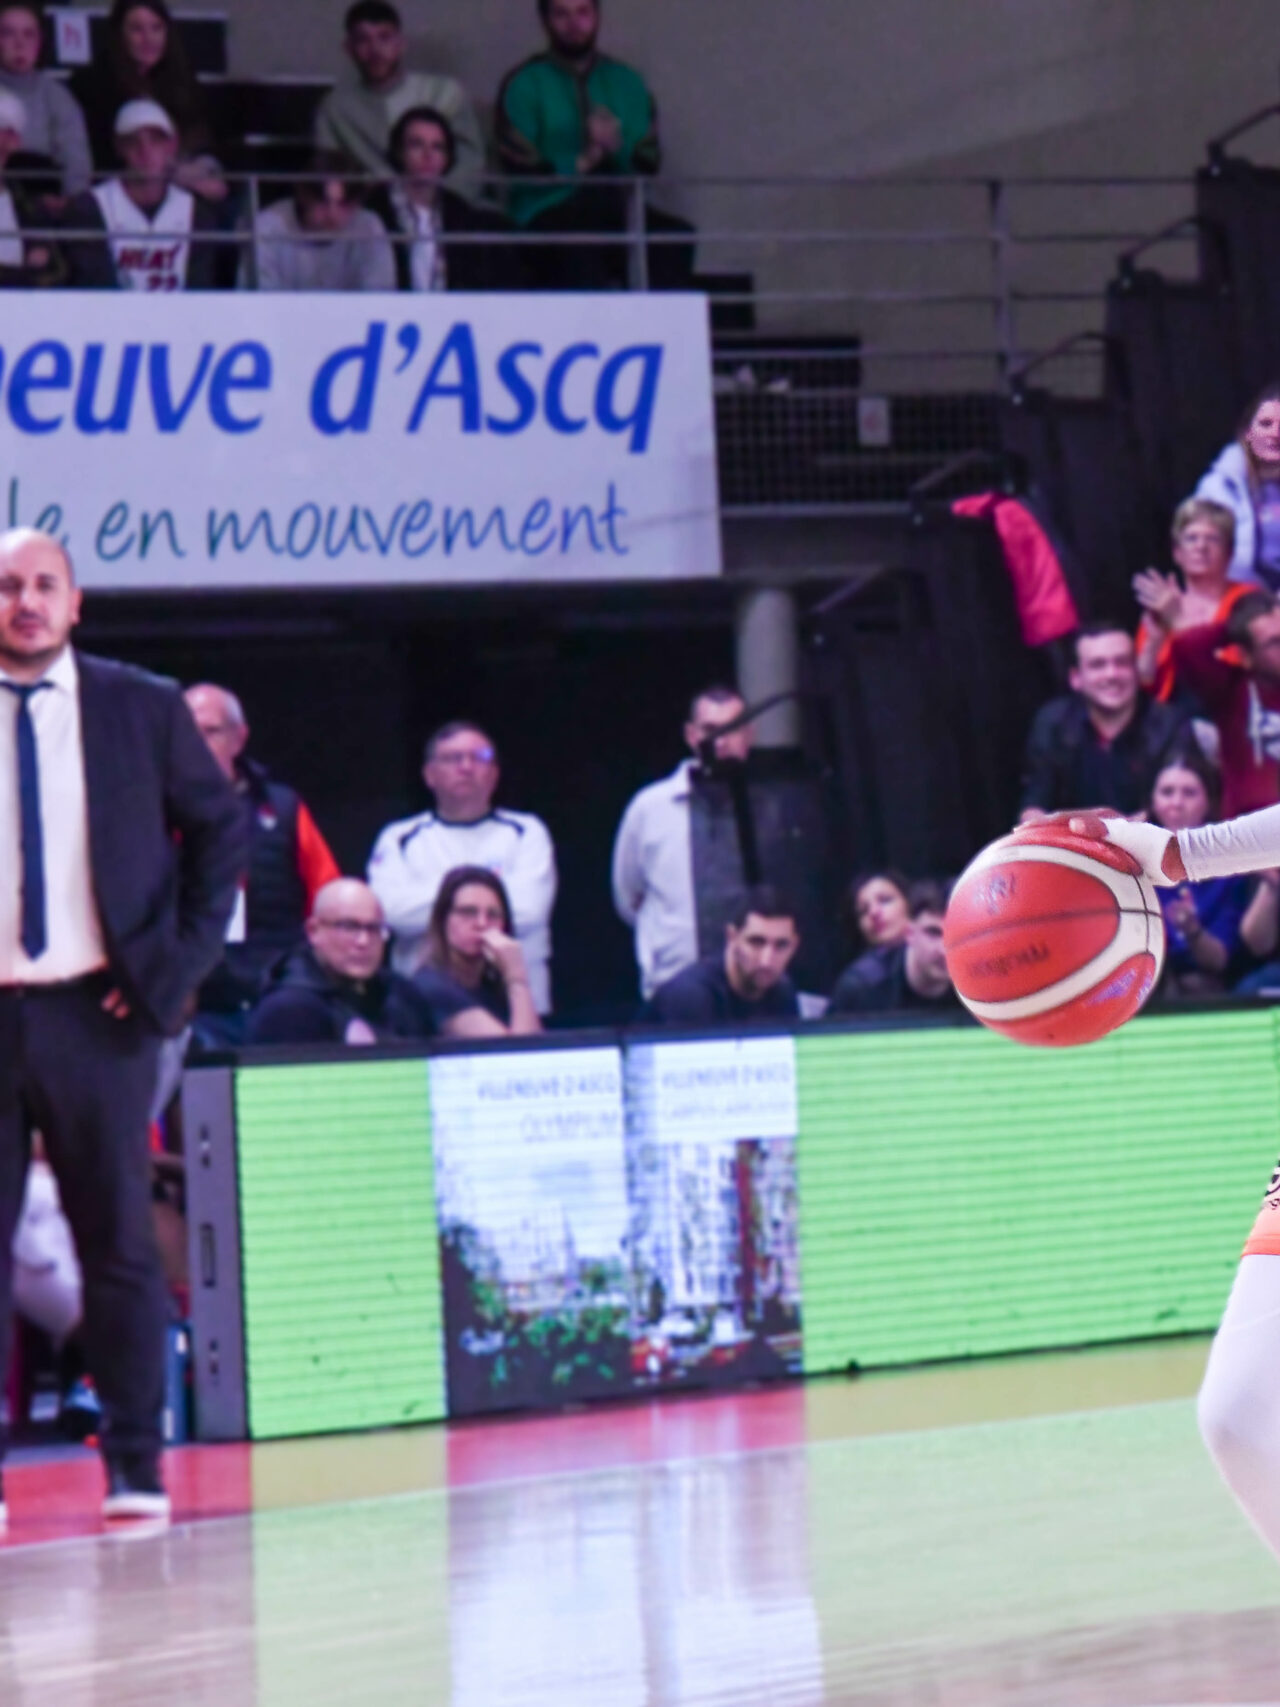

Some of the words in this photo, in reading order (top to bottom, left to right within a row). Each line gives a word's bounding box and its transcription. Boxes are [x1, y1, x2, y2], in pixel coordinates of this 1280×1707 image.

[0, 340, 272, 435] euve
[100, 502, 187, 561] en
[208, 481, 628, 558] mouvement
